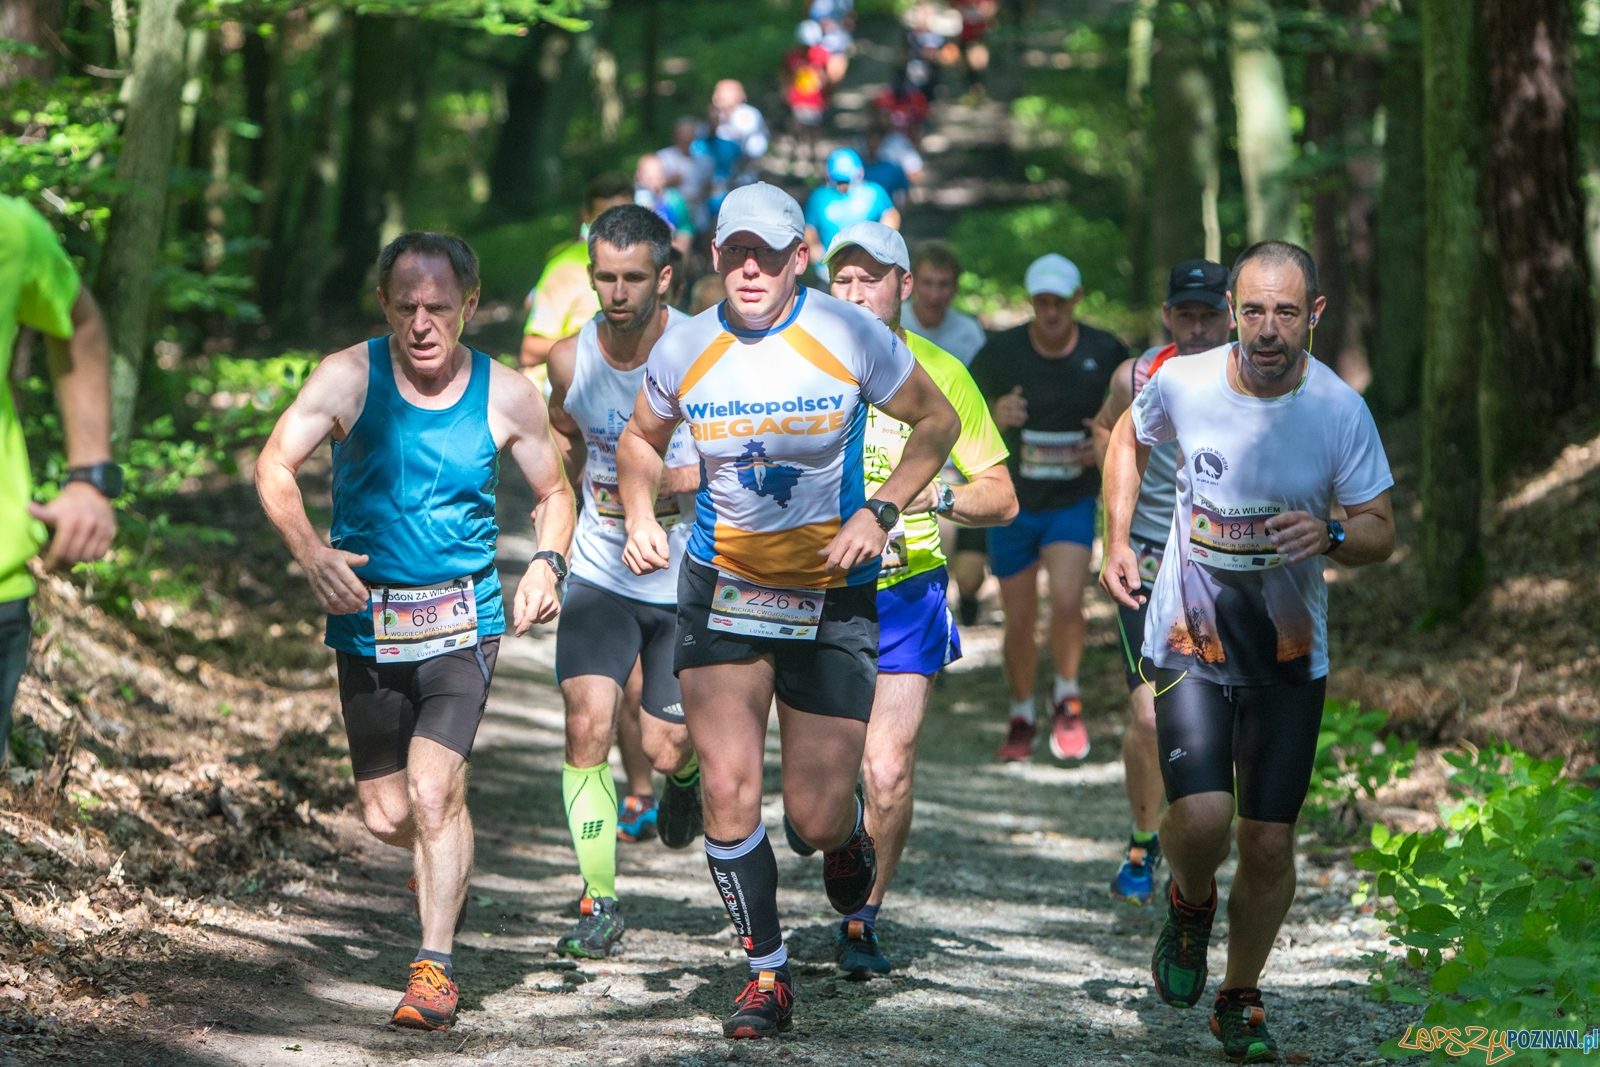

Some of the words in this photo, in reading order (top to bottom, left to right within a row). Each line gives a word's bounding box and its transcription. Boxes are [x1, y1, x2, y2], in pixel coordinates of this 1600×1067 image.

[686, 394, 844, 420] Wielkopolscy
[691, 410, 846, 442] BIEGACZE
[1228, 508, 1240, 516] ZA
[1242, 506, 1281, 515] WILKIEM
[1217, 521, 1256, 540] 184
[383, 592, 414, 601] OGOŃ
[416, 592, 428, 600] ZA
[746, 588, 791, 610] 226
[411, 605, 438, 627] 68
[417, 648, 440, 658] LUVENA
